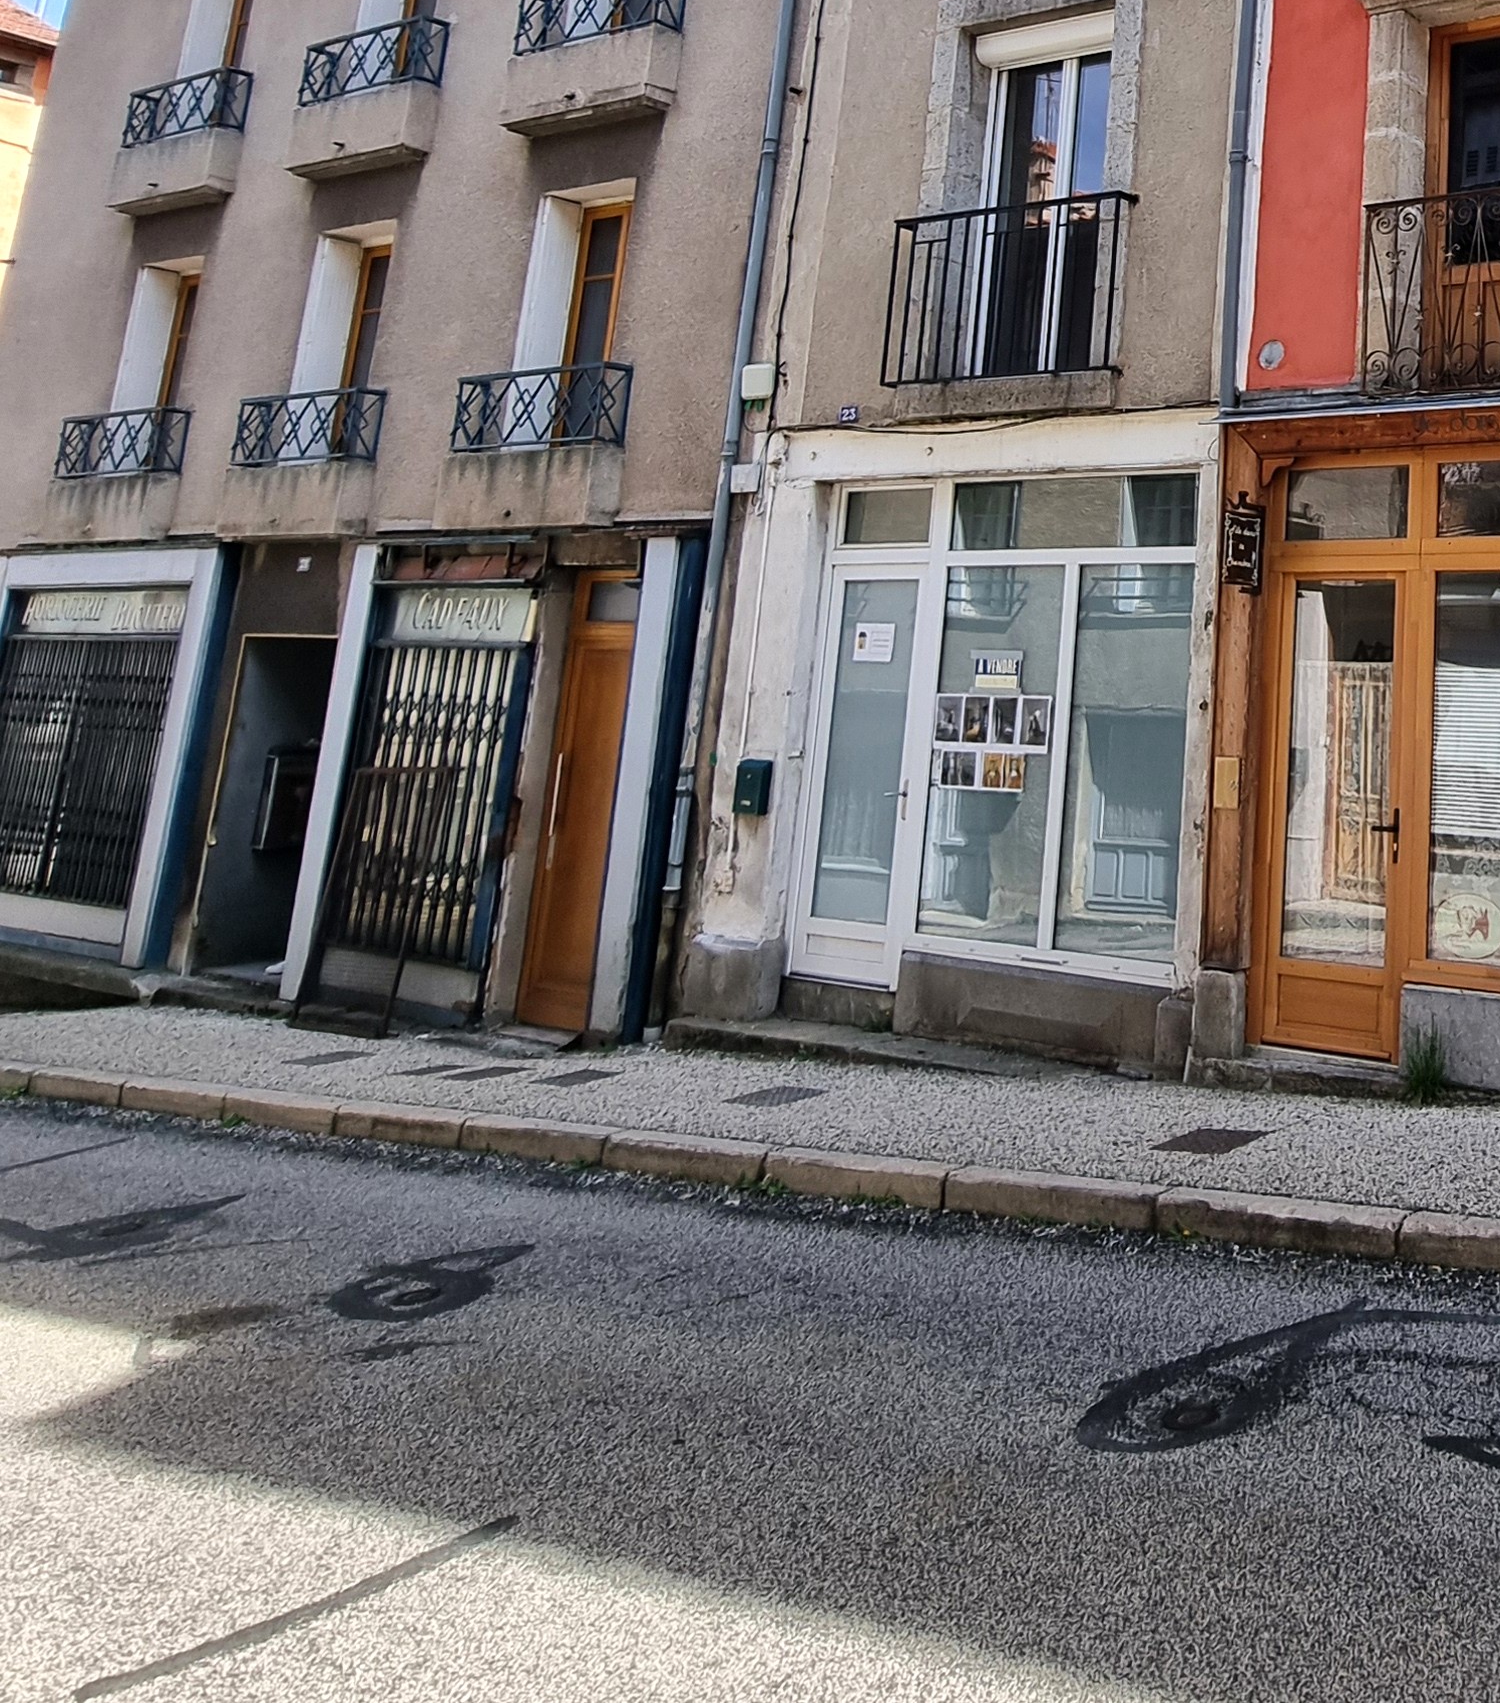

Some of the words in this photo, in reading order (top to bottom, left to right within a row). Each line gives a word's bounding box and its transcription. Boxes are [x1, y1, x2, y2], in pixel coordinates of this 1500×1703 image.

[841, 407, 856, 421] 23
[22, 595, 107, 626] HORLOGERIE
[412, 591, 510, 631] CADEAUX
[987, 658, 1018, 674] VENDRE
